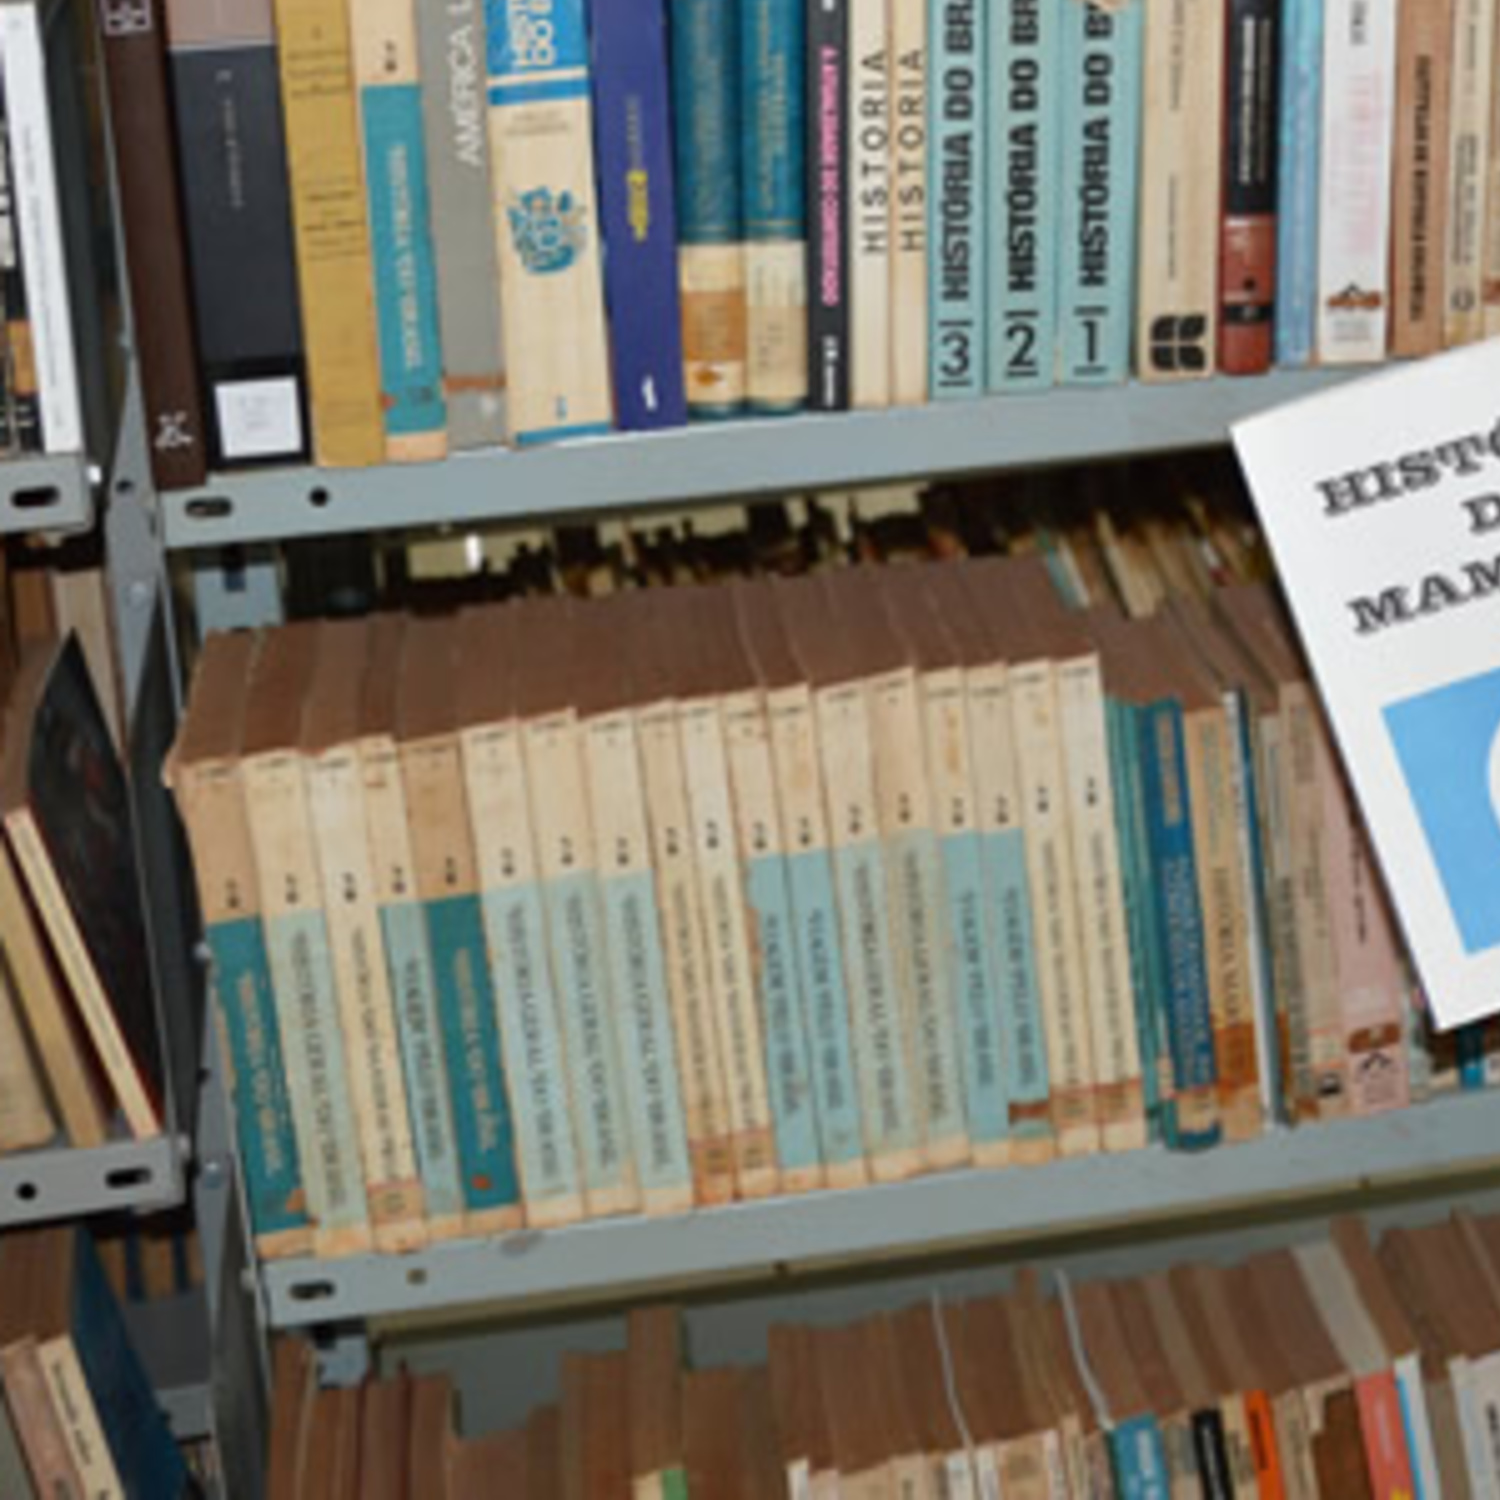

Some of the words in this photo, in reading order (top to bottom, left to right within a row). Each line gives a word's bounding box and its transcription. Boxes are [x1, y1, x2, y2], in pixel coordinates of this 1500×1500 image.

[944, 66, 974, 121] DO
[1009, 58, 1040, 111] DO
[1083, 53, 1114, 106] DO
[861, 49, 889, 252] HISTORIA
[898, 51, 925, 252] HISTORIA
[939, 330, 971, 378] 3
[1006, 323, 1037, 368] 2
[1082, 319, 1097, 363] 1
